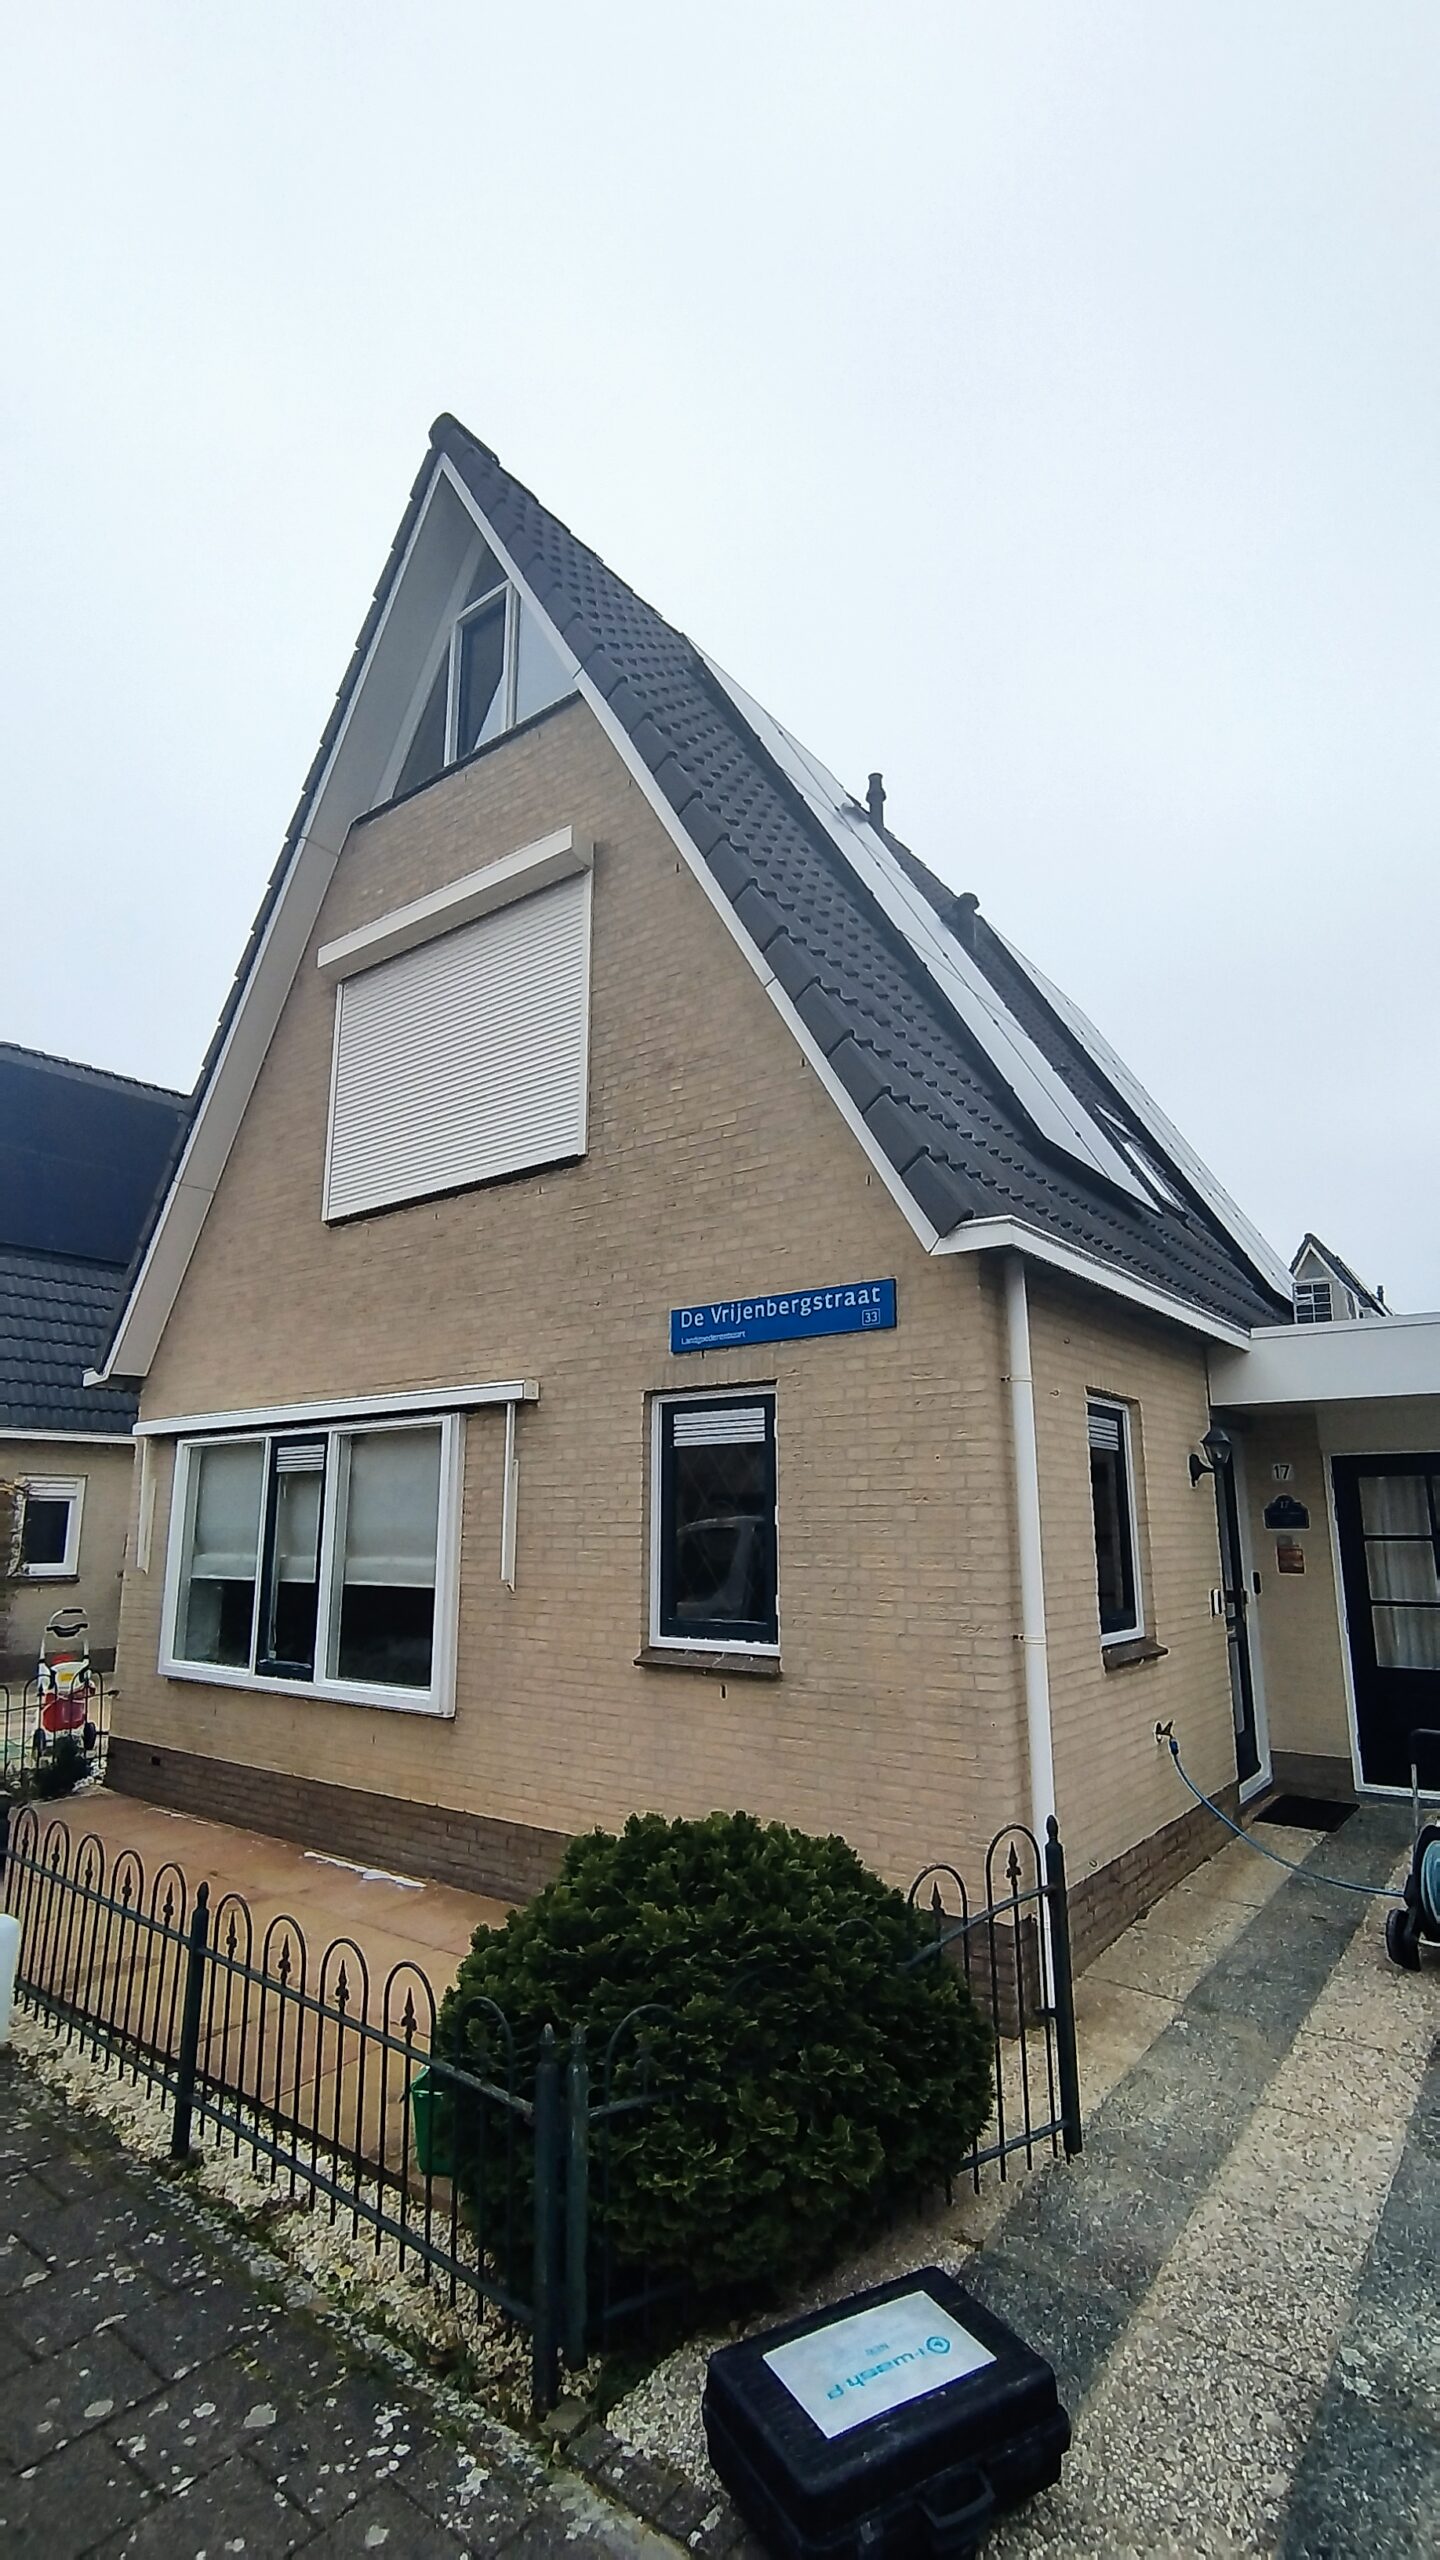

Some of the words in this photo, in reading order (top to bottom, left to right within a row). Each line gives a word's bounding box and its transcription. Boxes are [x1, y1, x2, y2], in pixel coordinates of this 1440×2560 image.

[681, 1311, 704, 1329] De
[711, 1286, 881, 1325] Vrijenbergstraat
[864, 1312, 878, 1323] 33
[1273, 1464, 1290, 1480] 17
